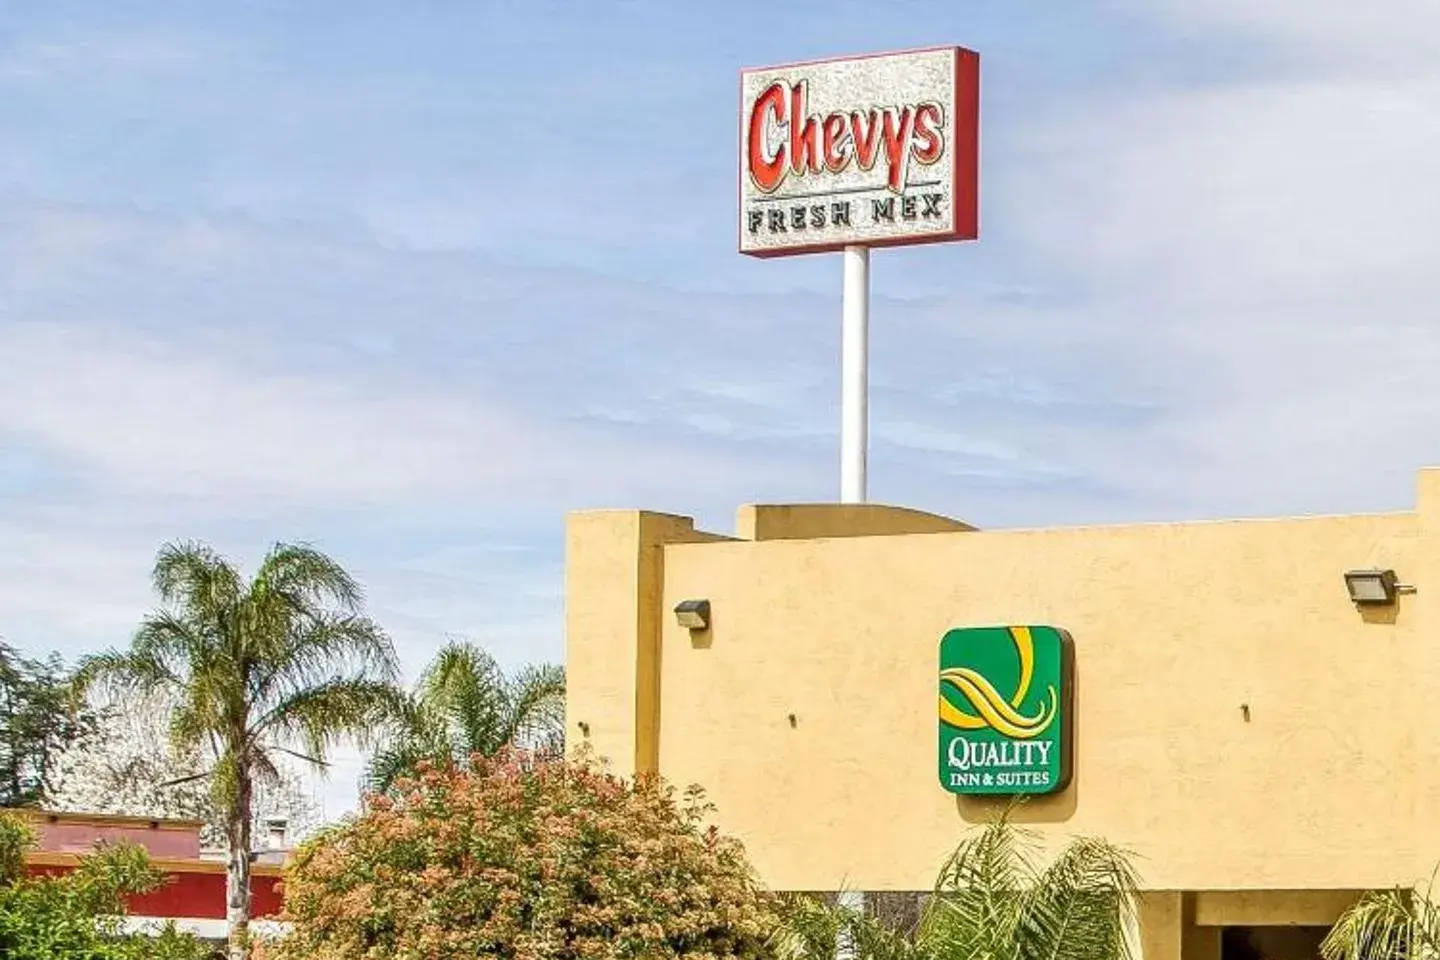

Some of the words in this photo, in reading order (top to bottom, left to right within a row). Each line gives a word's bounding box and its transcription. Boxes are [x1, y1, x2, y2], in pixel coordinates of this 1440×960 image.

[749, 79, 945, 194] Chevys
[748, 200, 850, 233] FRESH
[872, 193, 942, 223] MEX
[948, 737, 1052, 770] QUALITY
[950, 773, 980, 786] INN
[982, 772, 994, 786] &
[996, 772, 1049, 785] SUITES
